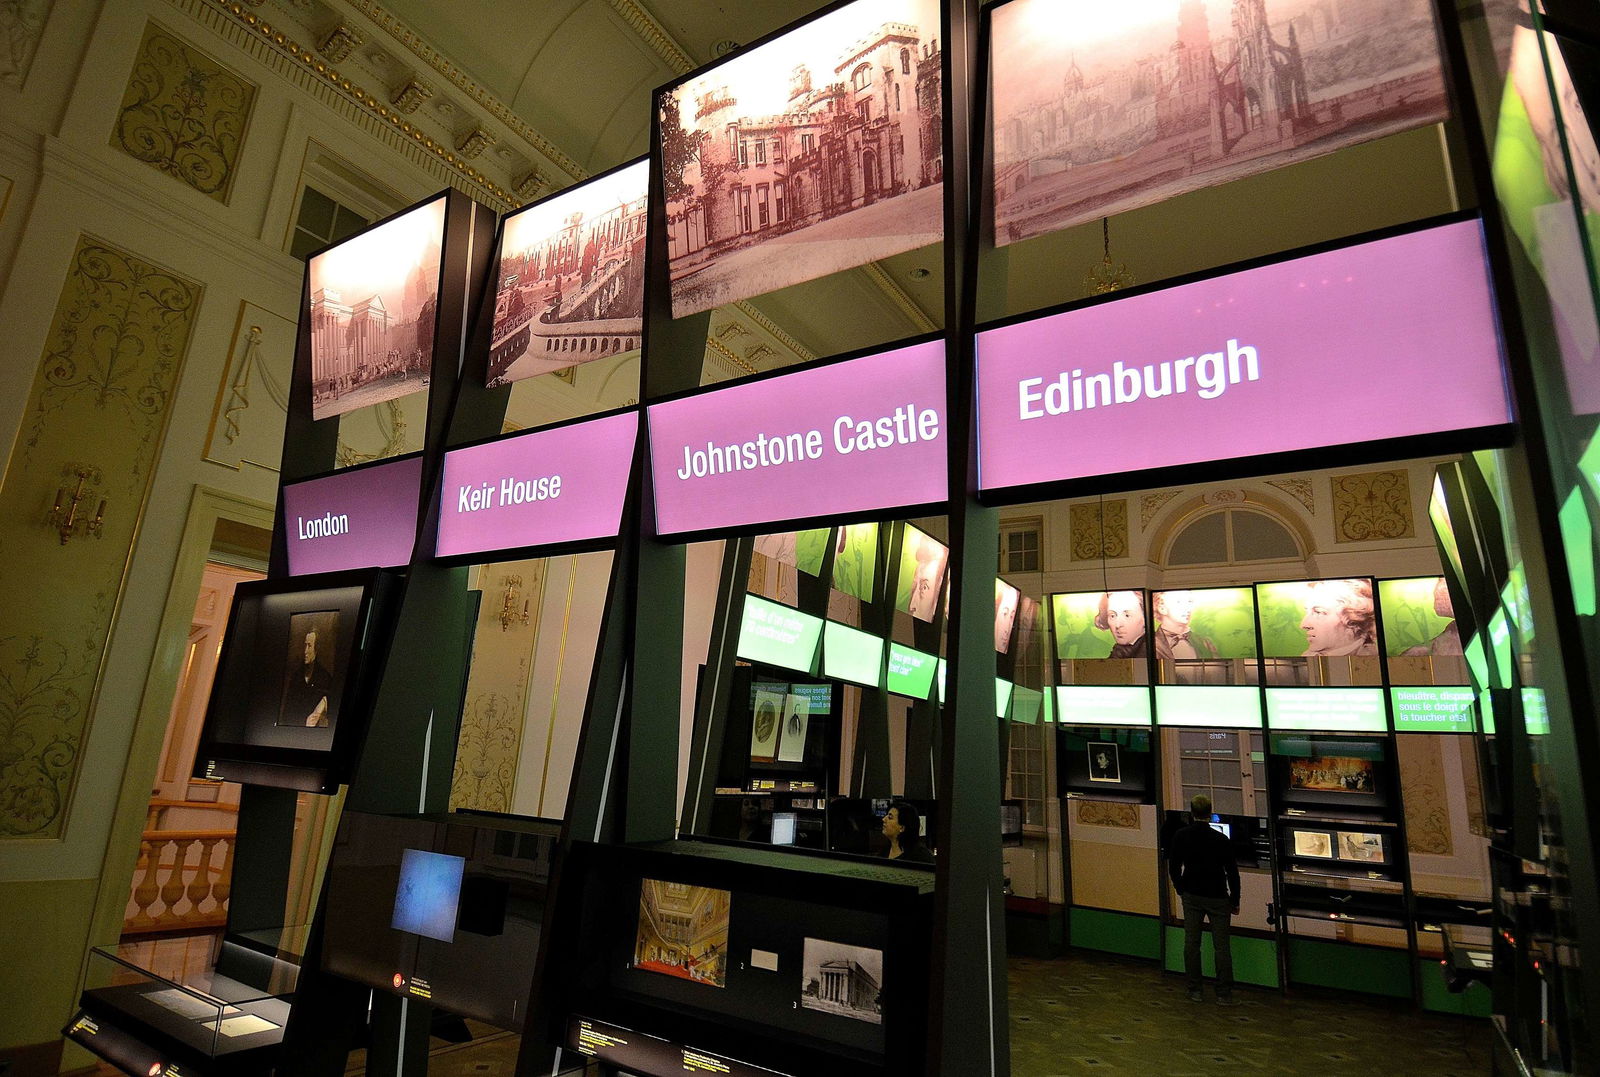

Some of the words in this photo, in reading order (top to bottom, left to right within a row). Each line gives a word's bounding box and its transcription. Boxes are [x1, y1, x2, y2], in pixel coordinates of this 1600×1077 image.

[1019, 339, 1260, 421] Edinburgh
[677, 429, 824, 480] Johnstone
[833, 403, 939, 455] Castle
[457, 484, 494, 514] Keir
[499, 474, 562, 506] House
[298, 511, 350, 540] London
[1399, 703, 1422, 711] sous
[1423, 703, 1432, 711] le
[1434, 703, 1458, 713] doigt
[1400, 712, 1409, 722] la
[1411, 713, 1447, 722] toucher
[792, 1001, 797, 1009] 3
